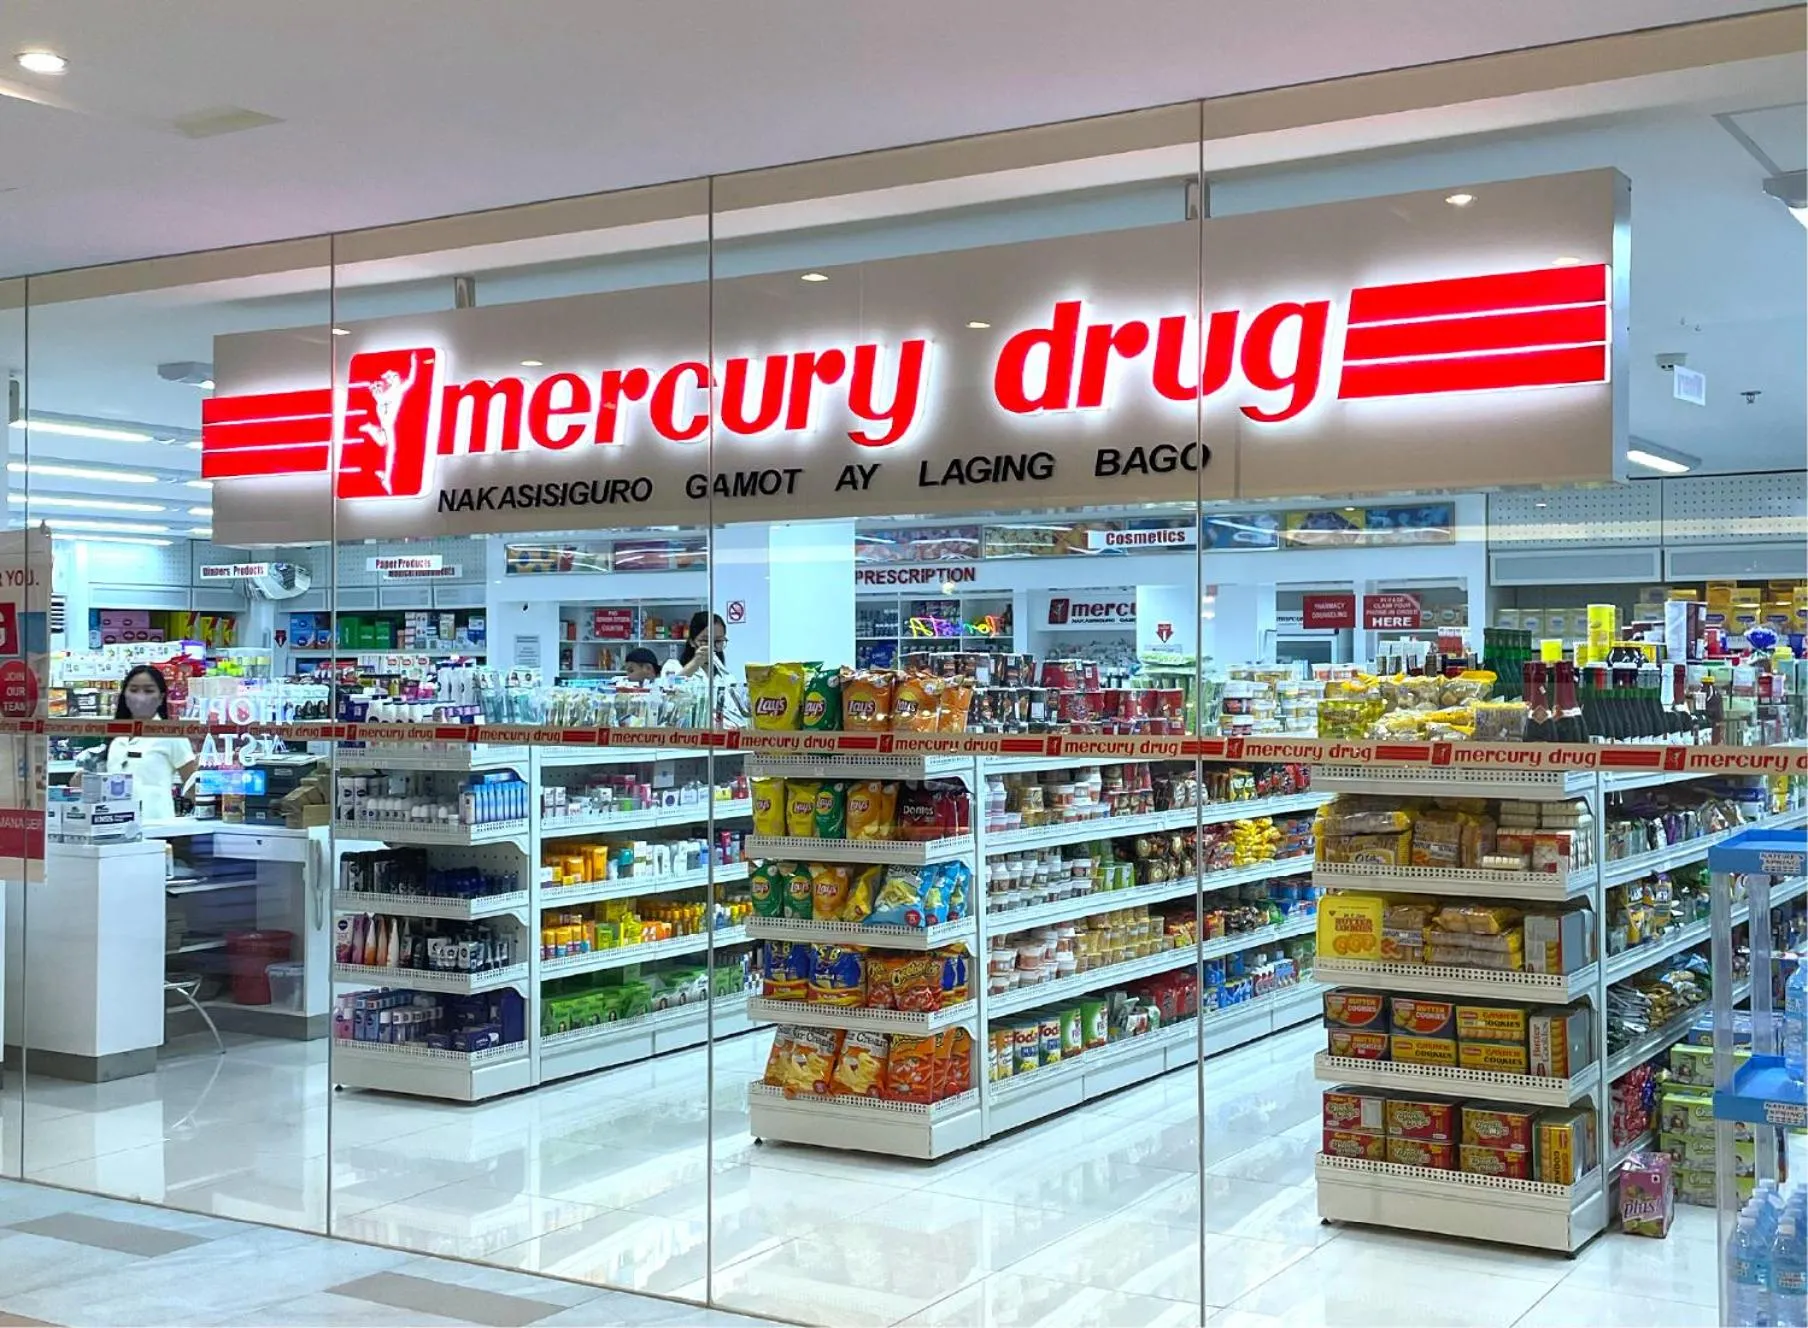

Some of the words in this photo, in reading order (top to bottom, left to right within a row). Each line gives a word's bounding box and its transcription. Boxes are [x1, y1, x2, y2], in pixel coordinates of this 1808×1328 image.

[436, 339, 926, 448] mercury
[994, 300, 1331, 424] drug
[438, 477, 652, 513] NAKASISIGURO
[686, 469, 802, 499] GAMOT
[836, 464, 880, 491] AY
[919, 451, 1054, 486] LAGING
[1096, 441, 1211, 477] BAGO
[1105, 529, 1186, 546] Cosmetics
[398, 557, 431, 570] Products
[6, 570, 39, 586] YOU.
[855, 567, 976, 585] PRESCRIPTION
[1372, 617, 1413, 627] HERE
[7, 686, 26, 697] OUR
[756, 697, 786, 717] Lay's
[849, 698, 875, 717] Lay's
[296, 725, 320, 738] drug
[358, 728, 405, 740] mercury
[408, 727, 434, 740] drug
[480, 731, 531, 743] mercury
[533, 730, 560, 743] drug
[611, 733, 665, 745] mercury
[669, 732, 698, 745] drug
[741, 736, 799, 748] mercury
[804, 735, 835, 749] drug
[895, 738, 958, 752] mercury
[963, 737, 998, 752] drug
[1064, 741, 1134, 756] mercury
[1140, 739, 1178, 756] drug
[1245, 744, 1323, 760] mercury
[1329, 743, 1371, 762] drug
[1454, 748, 1541, 768] mercury
[1548, 748, 1597, 769] drug
[1690, 752, 1789, 772] mercury
[903, 805, 934, 817] Doritos
[1416, 1012, 1446, 1020] COOKIES
[1415, 1050, 1452, 1059] COOKIES
[1484, 1057, 1522, 1066] COOKIES
